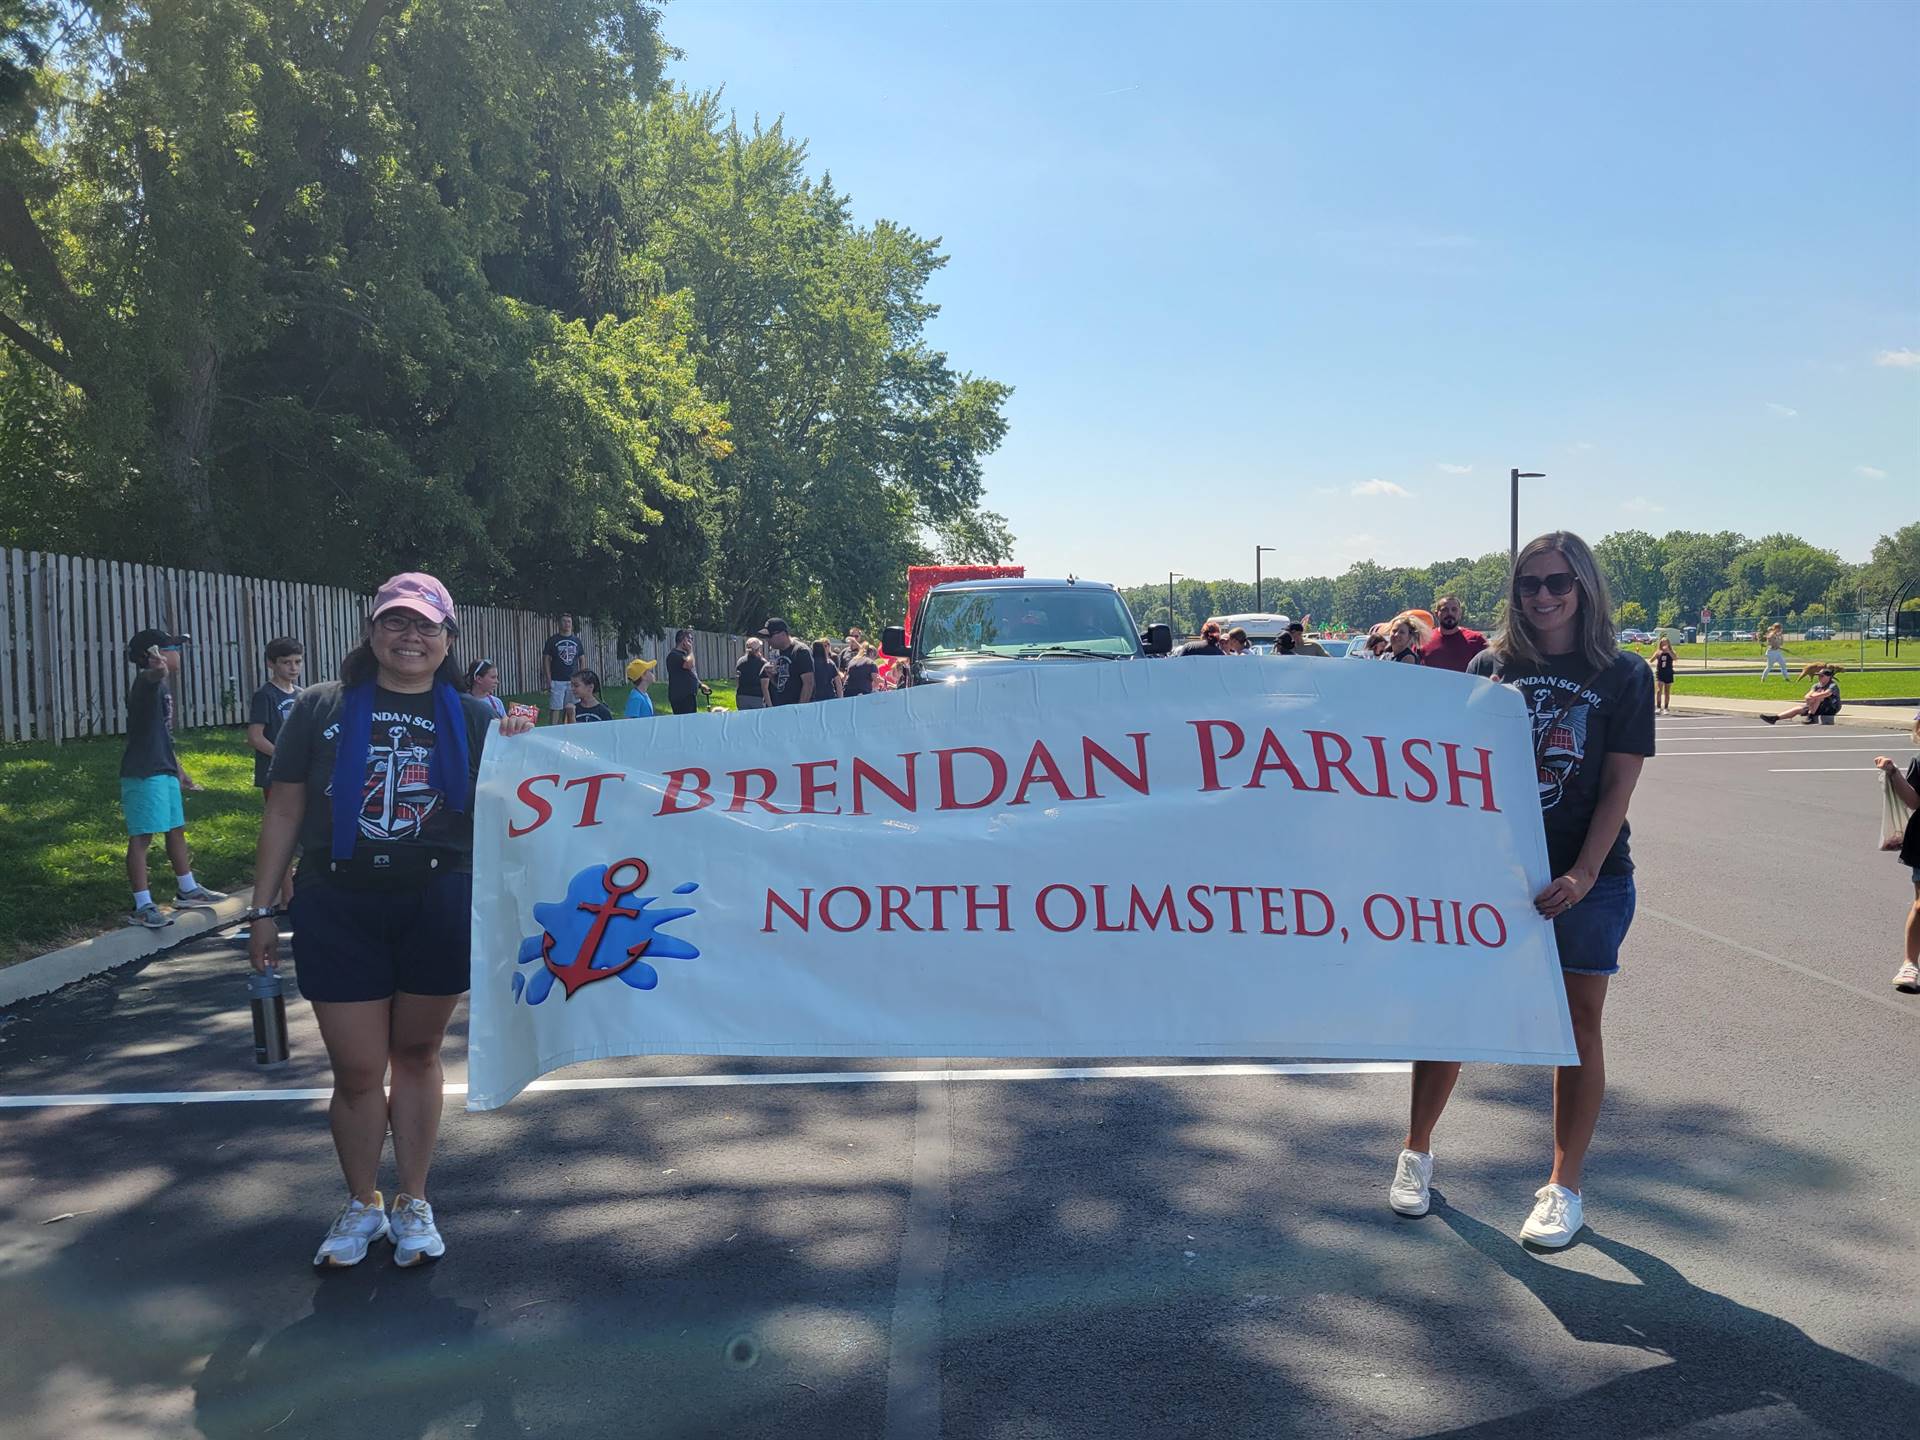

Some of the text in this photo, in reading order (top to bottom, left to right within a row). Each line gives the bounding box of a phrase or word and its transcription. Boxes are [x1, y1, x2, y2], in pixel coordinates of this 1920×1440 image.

[323, 723, 340, 740] ST
[371, 711, 412, 723] NDAN
[508, 719, 1502, 838] ST BRENDAN PARISH
[760, 883, 1507, 948] NORTH OLMSTED, OHIO
